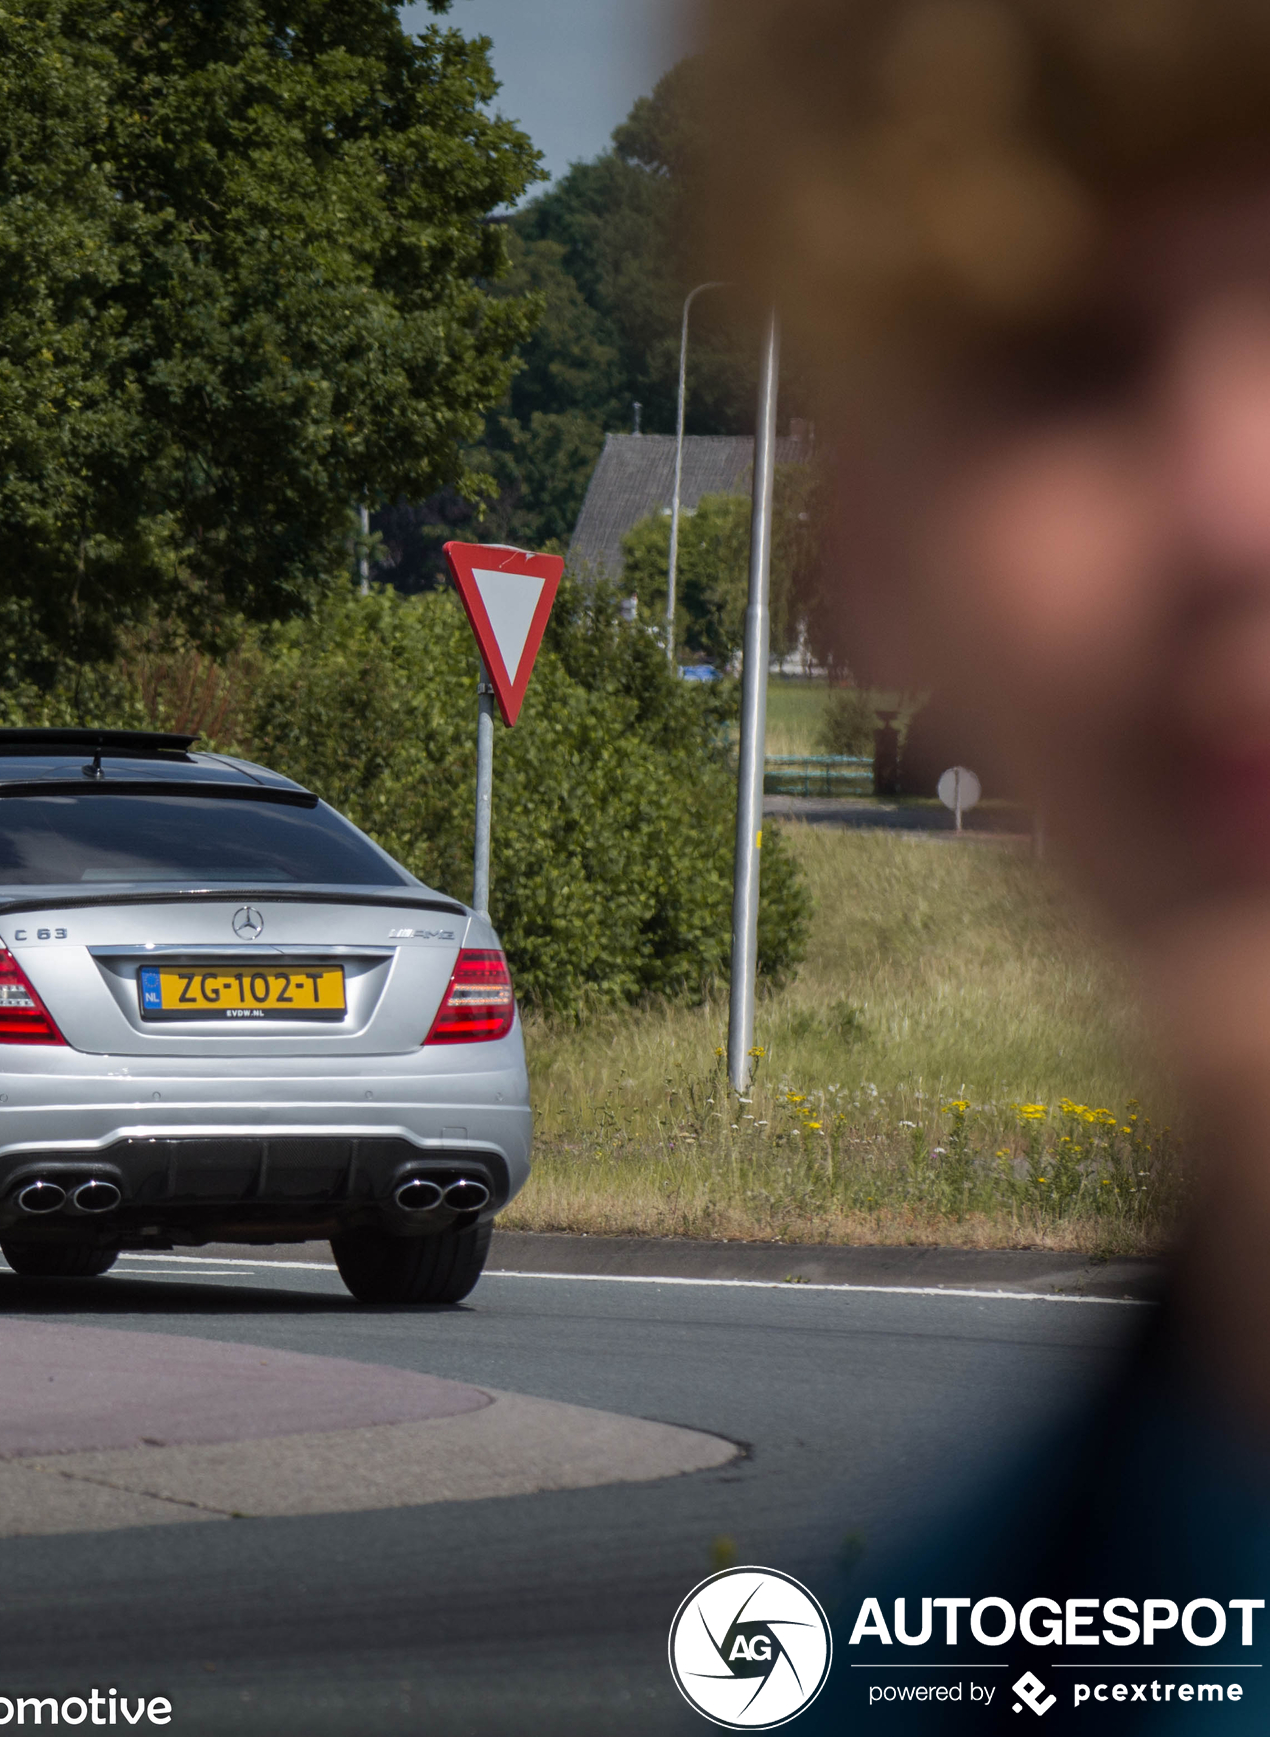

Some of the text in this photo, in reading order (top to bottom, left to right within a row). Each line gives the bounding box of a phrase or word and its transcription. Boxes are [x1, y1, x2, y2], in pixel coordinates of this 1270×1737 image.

[14, 928, 68, 941] C 63
[178, 972, 324, 1003] ZG-102-T
[145, 992, 160, 1003] NL
[226, 1009, 265, 1017] EVDW.NL
